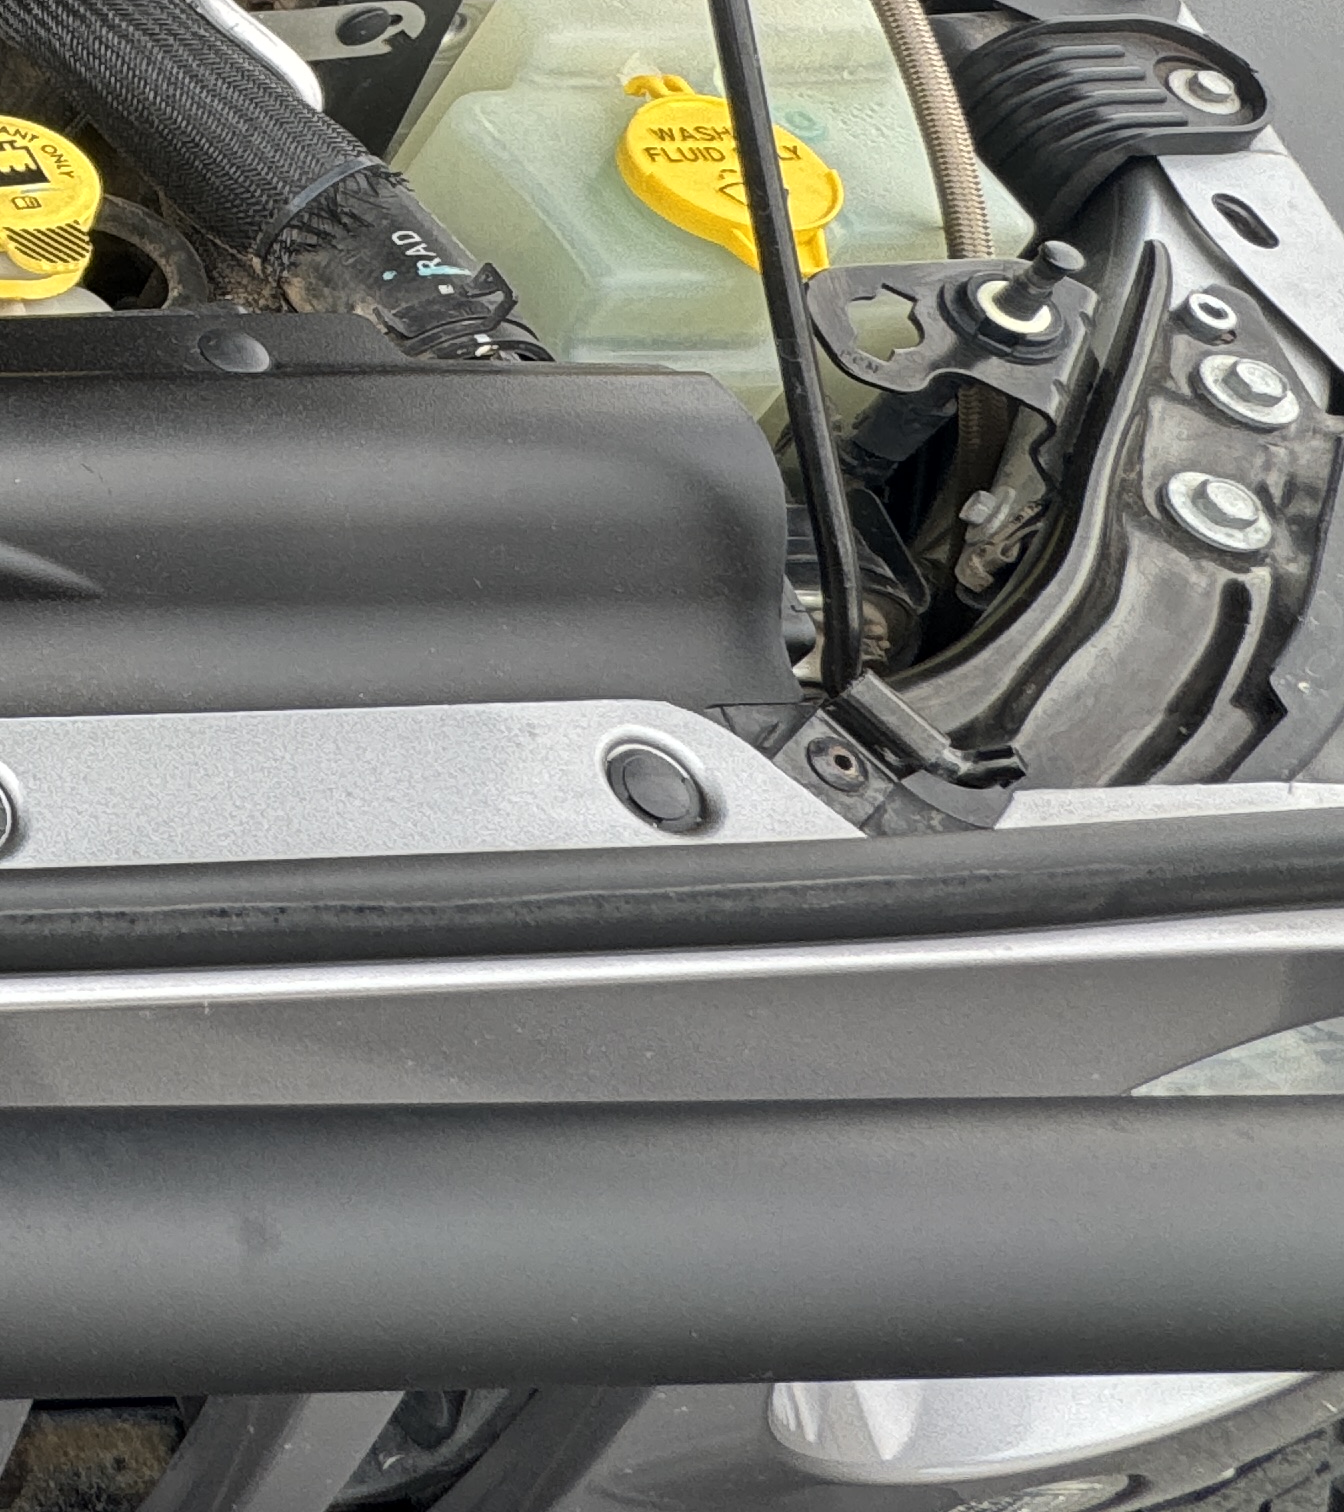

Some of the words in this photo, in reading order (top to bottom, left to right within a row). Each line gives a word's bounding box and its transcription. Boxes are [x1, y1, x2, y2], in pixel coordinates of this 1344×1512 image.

[648, 125, 735, 142] WASH
[40, 143, 75, 180] ONLY
[643, 146, 726, 163] FLUID
[391, 230, 441, 273] RAD
